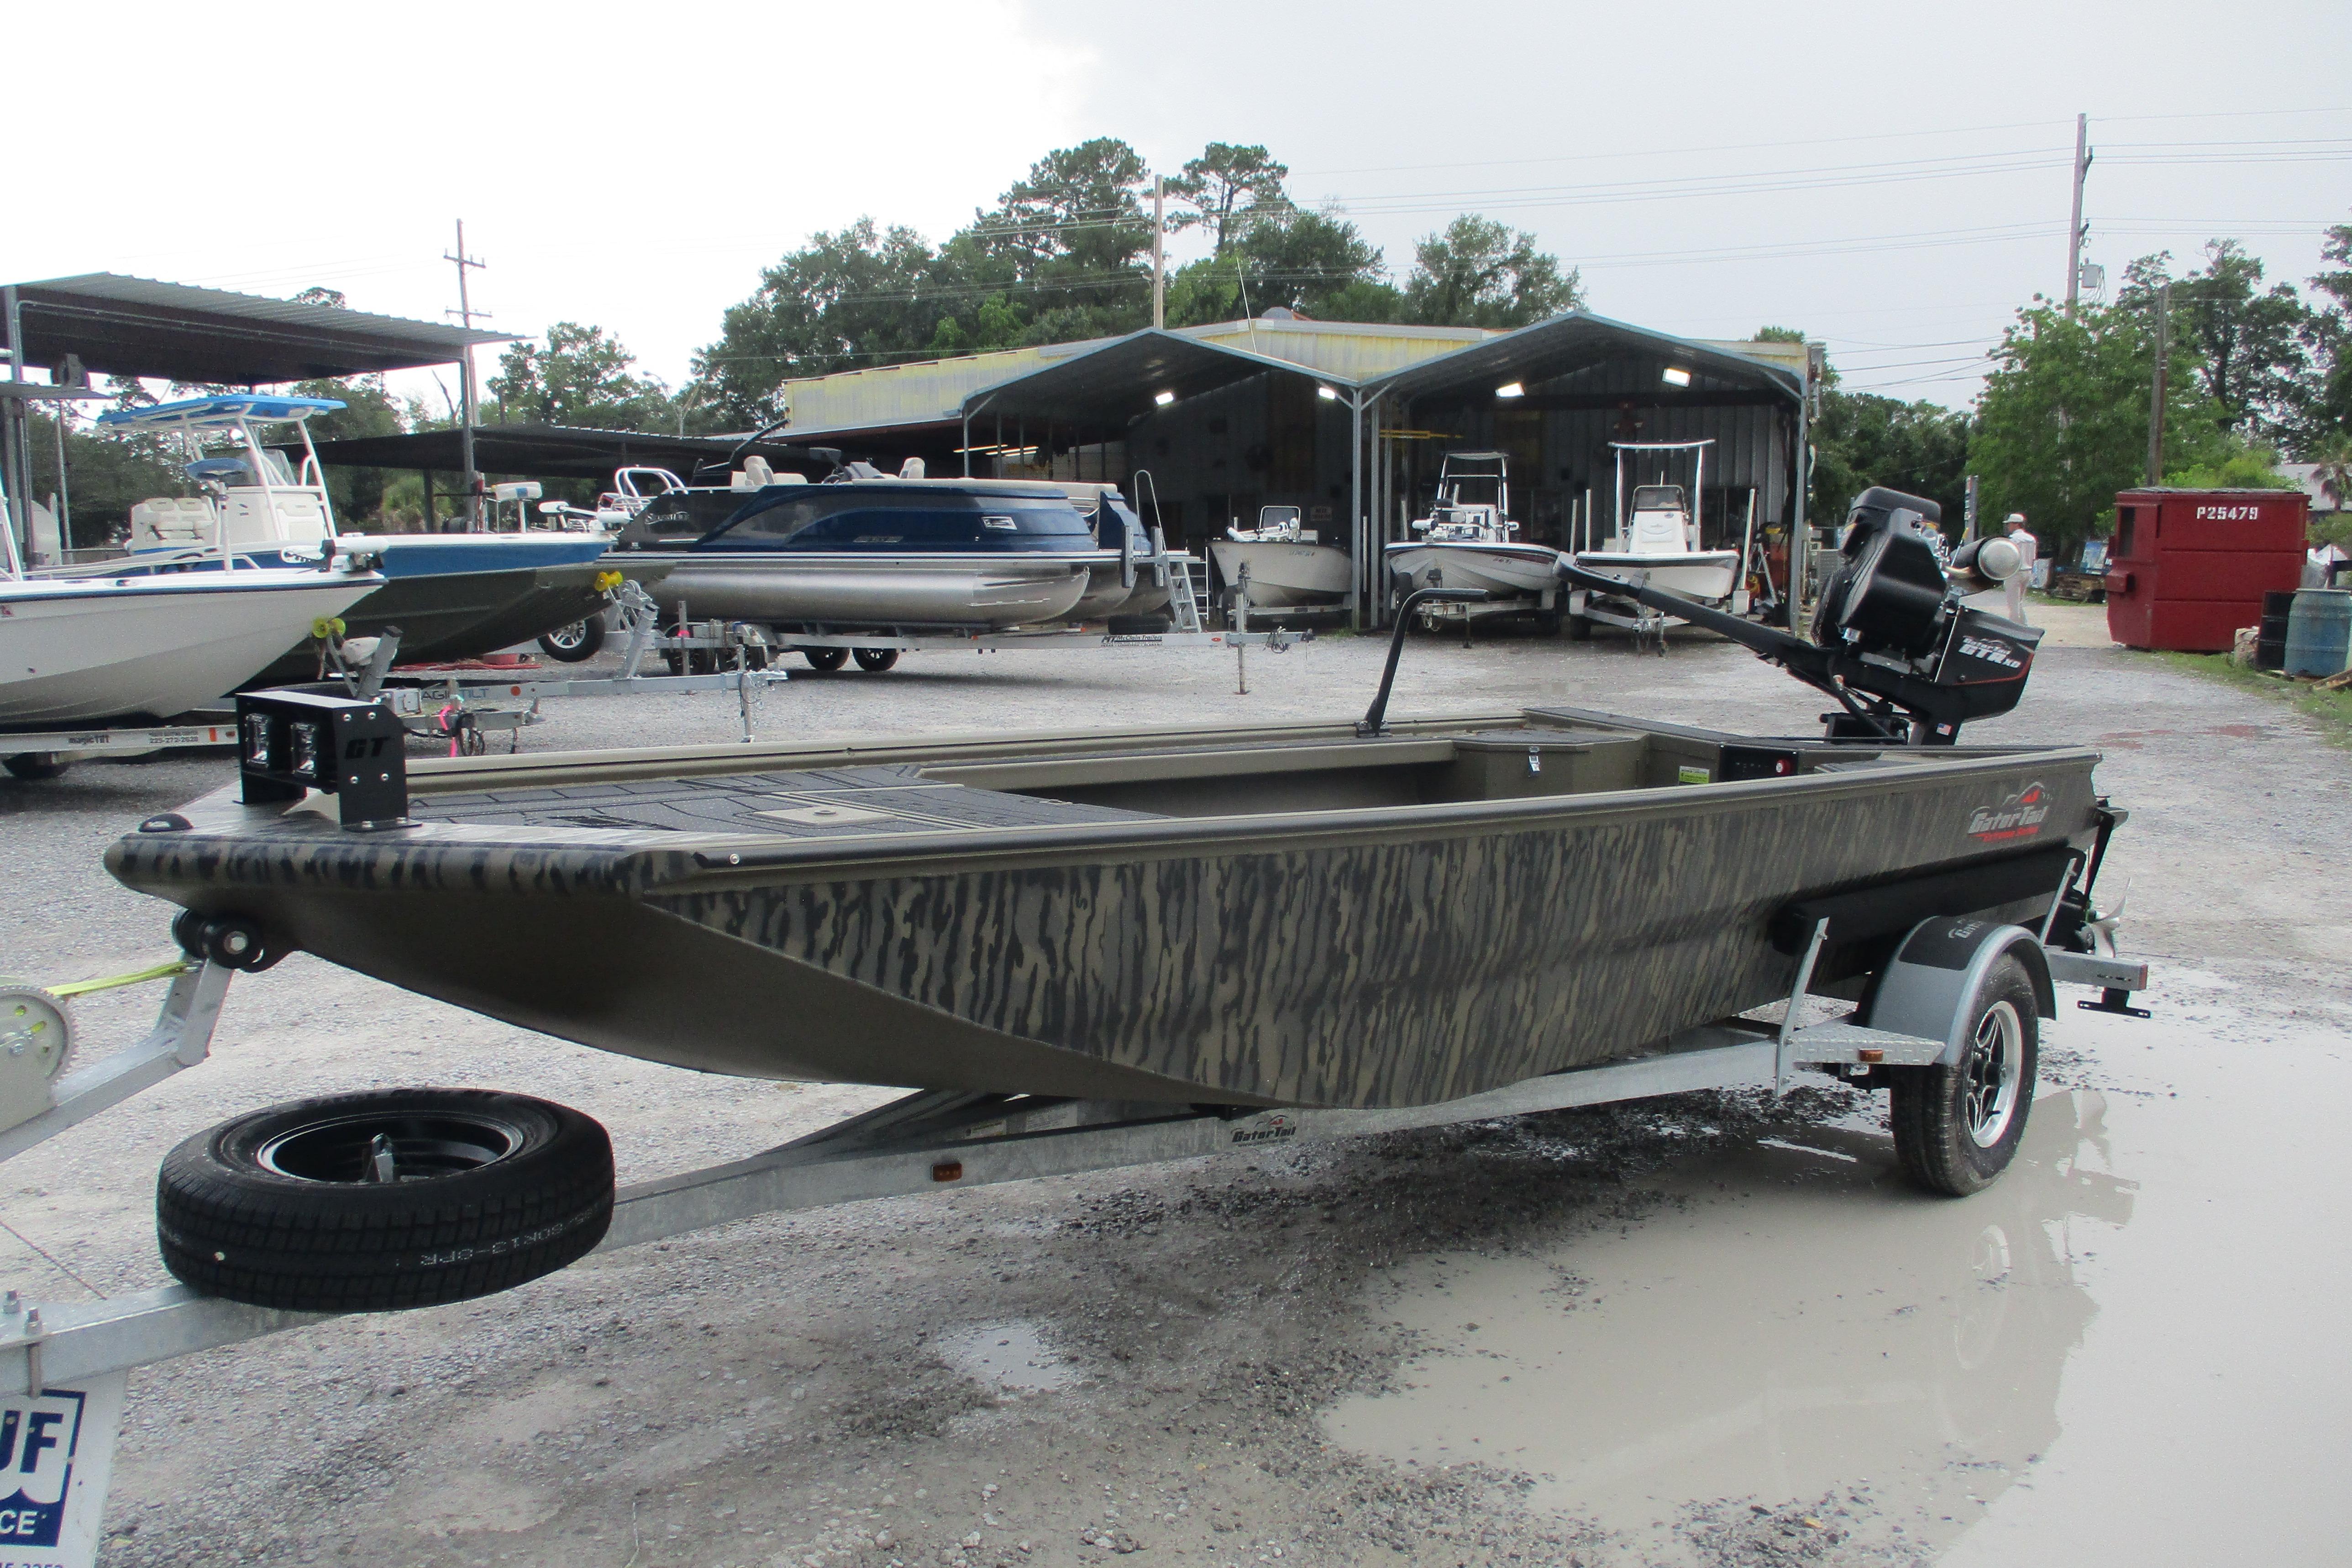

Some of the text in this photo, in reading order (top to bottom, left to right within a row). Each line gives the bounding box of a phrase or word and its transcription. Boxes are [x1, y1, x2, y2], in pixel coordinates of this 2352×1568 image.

[2197, 507, 2258, 520] P25479
[1958, 644, 2007, 664] GTR
[344, 736, 391, 760] GT
[1967, 805, 2049, 834] GatorTail
[1231, 1126, 1297, 1143] GatorTail
